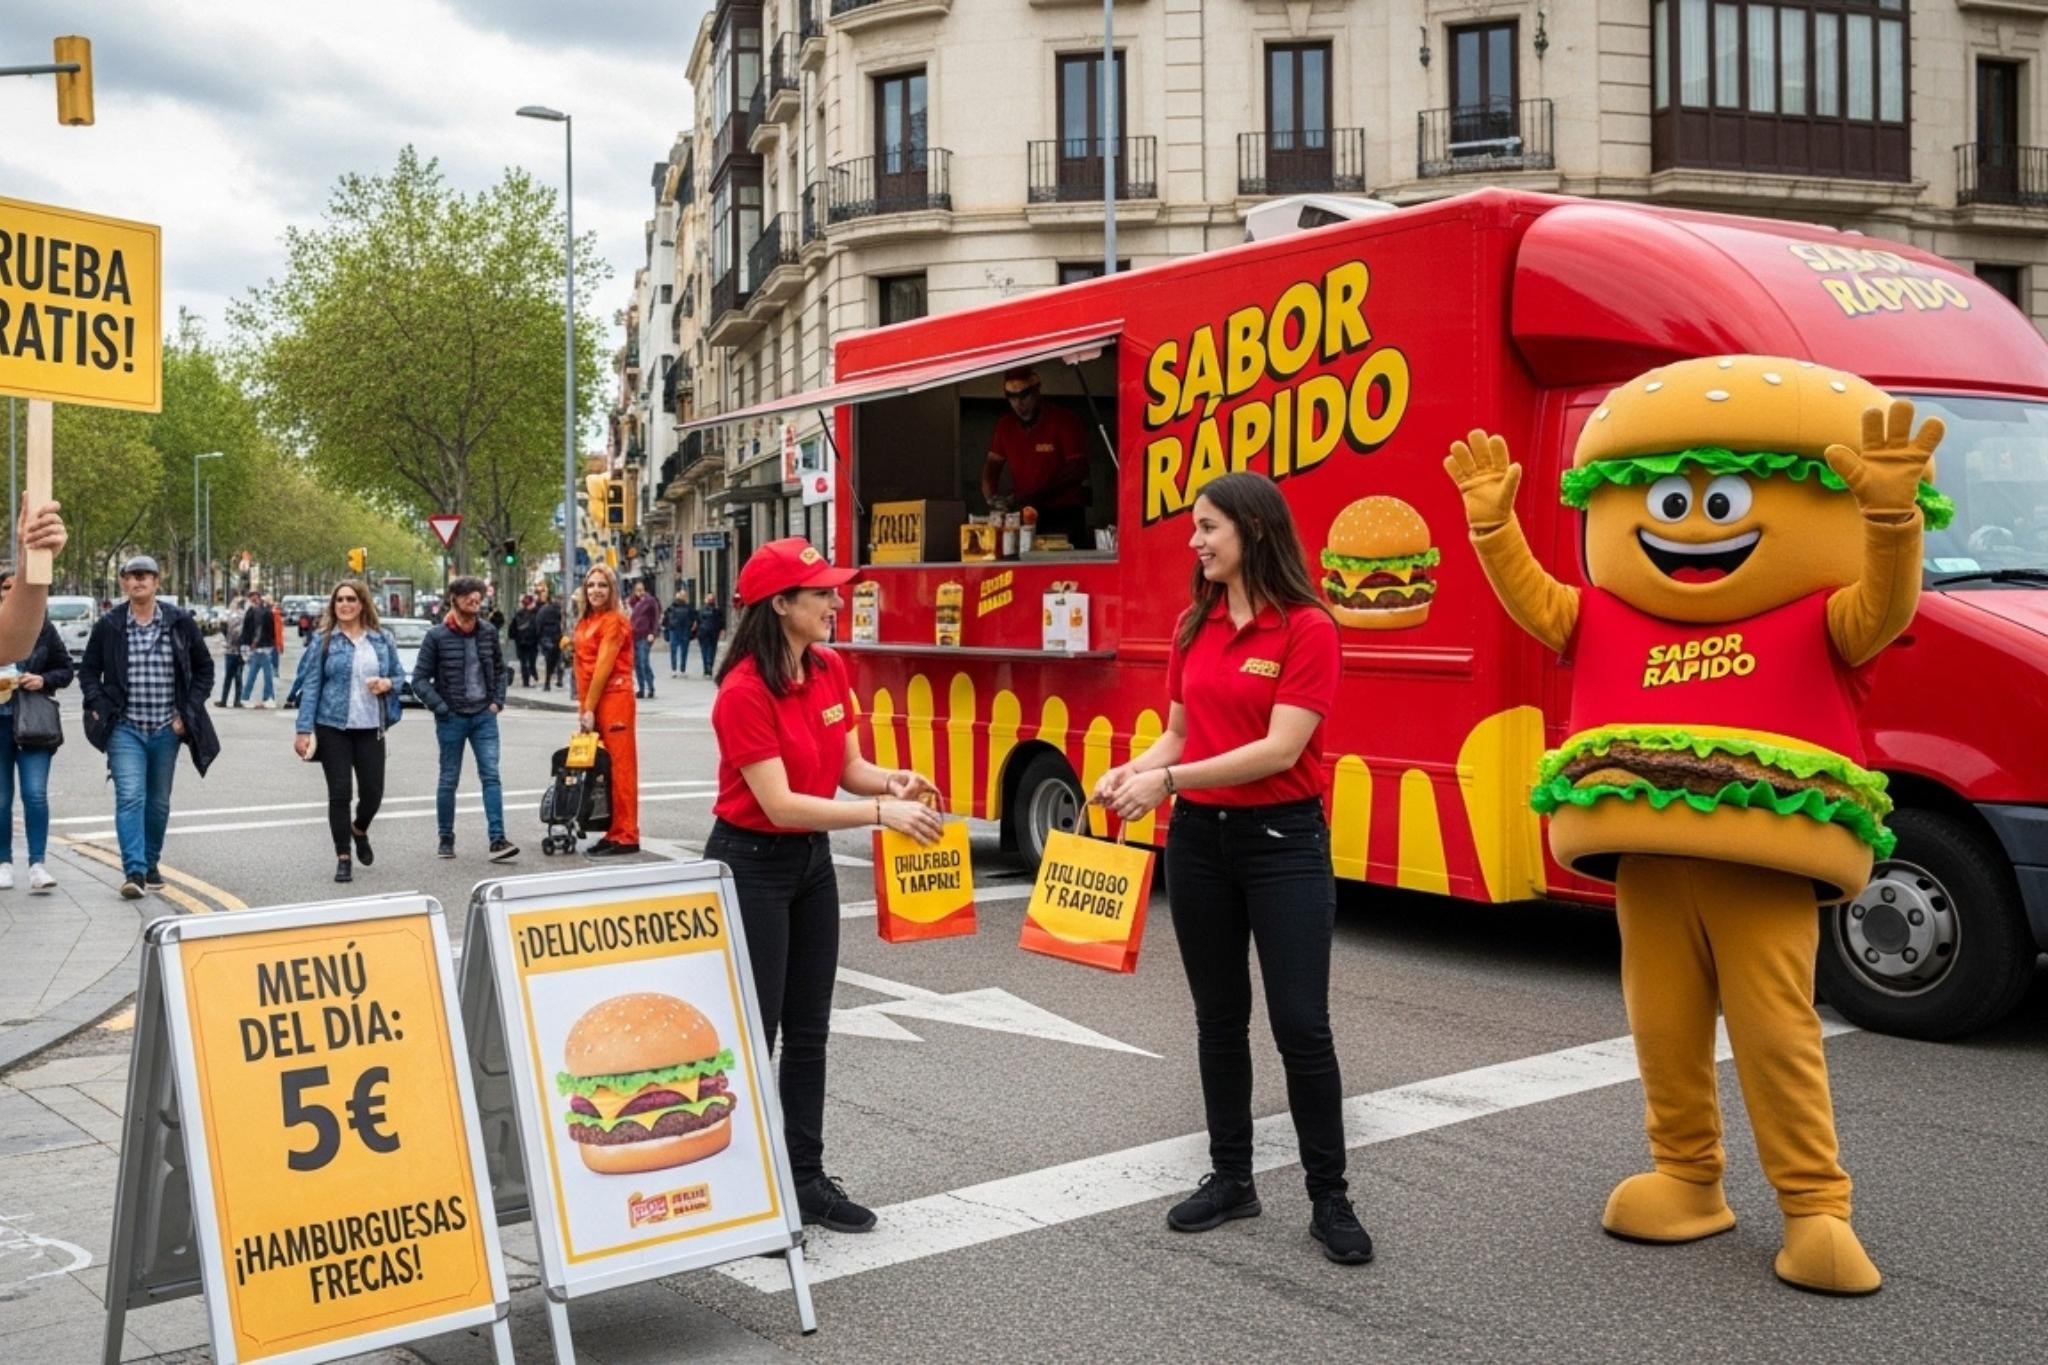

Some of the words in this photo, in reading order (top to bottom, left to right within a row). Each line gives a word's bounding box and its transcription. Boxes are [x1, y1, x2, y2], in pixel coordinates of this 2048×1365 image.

[1144, 260, 1372, 430] SABOR
[1143, 347, 1410, 527] RÁPIDO
[1647, 633, 1743, 665] SABOR
[1045, 884, 1056, 904] Y
[257, 941, 367, 1007] MENÚ
[239, 1011, 316, 1063] DEL
[322, 994, 404, 1050] DÍA:
[281, 1065, 401, 1172] 5€
[235, 1196, 467, 1286] ¡HAMBURGUESAS
[310, 1243, 423, 1304] FRECAS!
